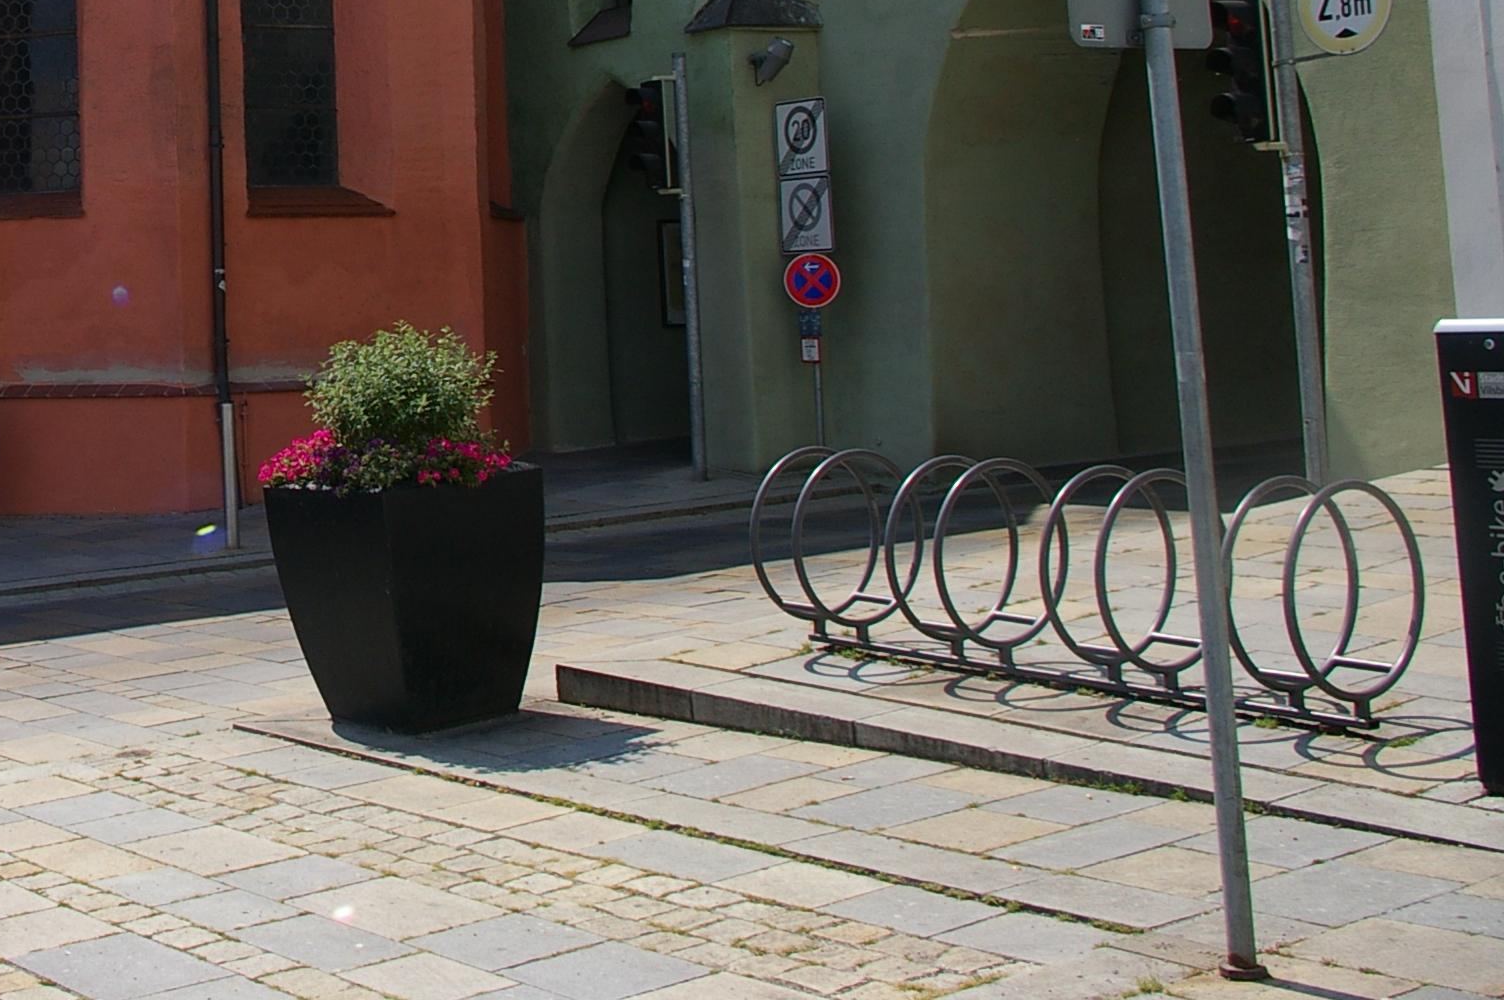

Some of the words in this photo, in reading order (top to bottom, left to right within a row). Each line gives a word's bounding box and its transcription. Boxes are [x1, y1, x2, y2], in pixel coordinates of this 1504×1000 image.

[791, 119, 810, 141] 20
[790, 157, 816, 171] ZONE
[794, 234, 820, 247] ZONE
